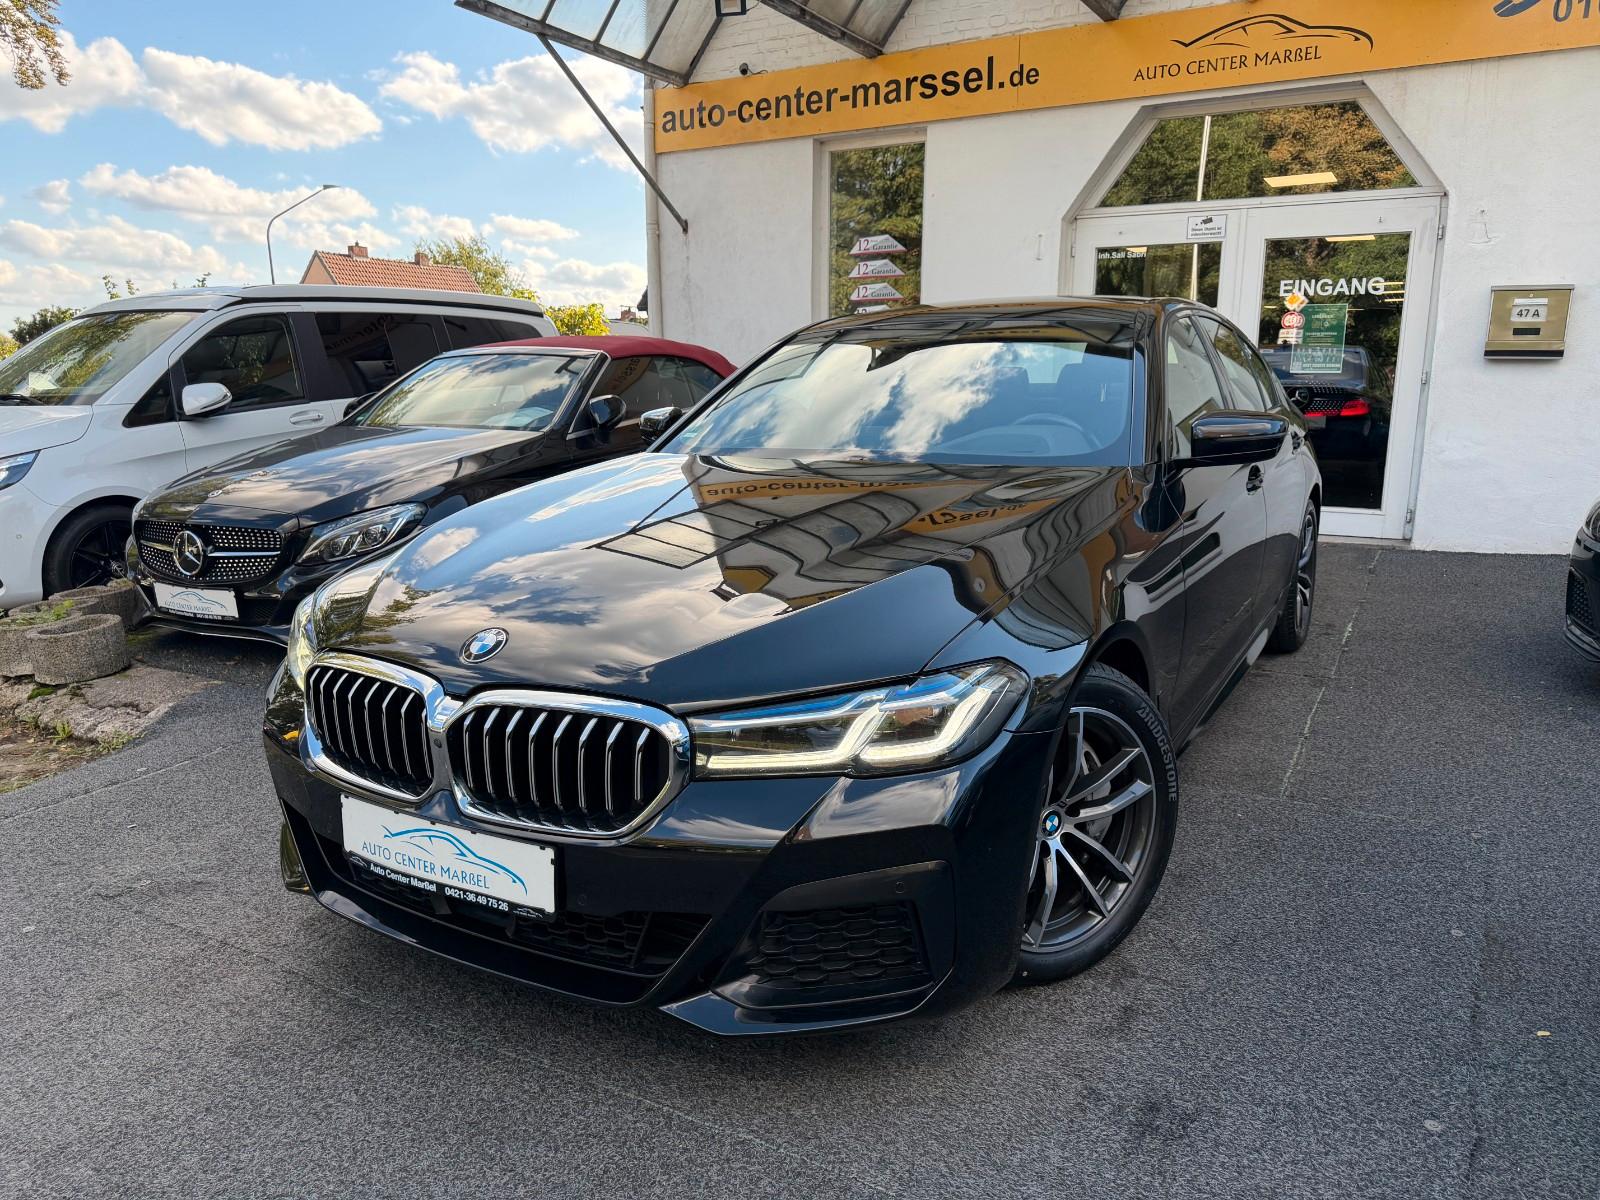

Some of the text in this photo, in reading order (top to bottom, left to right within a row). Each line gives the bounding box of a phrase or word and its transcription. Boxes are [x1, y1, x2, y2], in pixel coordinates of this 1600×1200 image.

[1133, 62, 1181, 82] AUTO
[1185, 54, 1249, 76] CENTER
[662, 56, 1040, 134] auto-center-marssel.de
[857, 239, 870, 251] 12
[856, 263, 869, 275] 12
[856, 286, 868, 298] 12
[1279, 277, 1385, 297] EINGANG
[1516, 309, 1540, 317] 47 A
[1136, 702, 1176, 801] BRIDGESTONE
[362, 841, 391, 861] AUTO
[394, 852, 436, 875] CENTER
[370, 863, 385, 876] Auto
[386, 869, 410, 885] Center
[477, 894, 487, 905] 49
[487, 897, 498, 908] 75
[498, 902, 509, 911] 26
